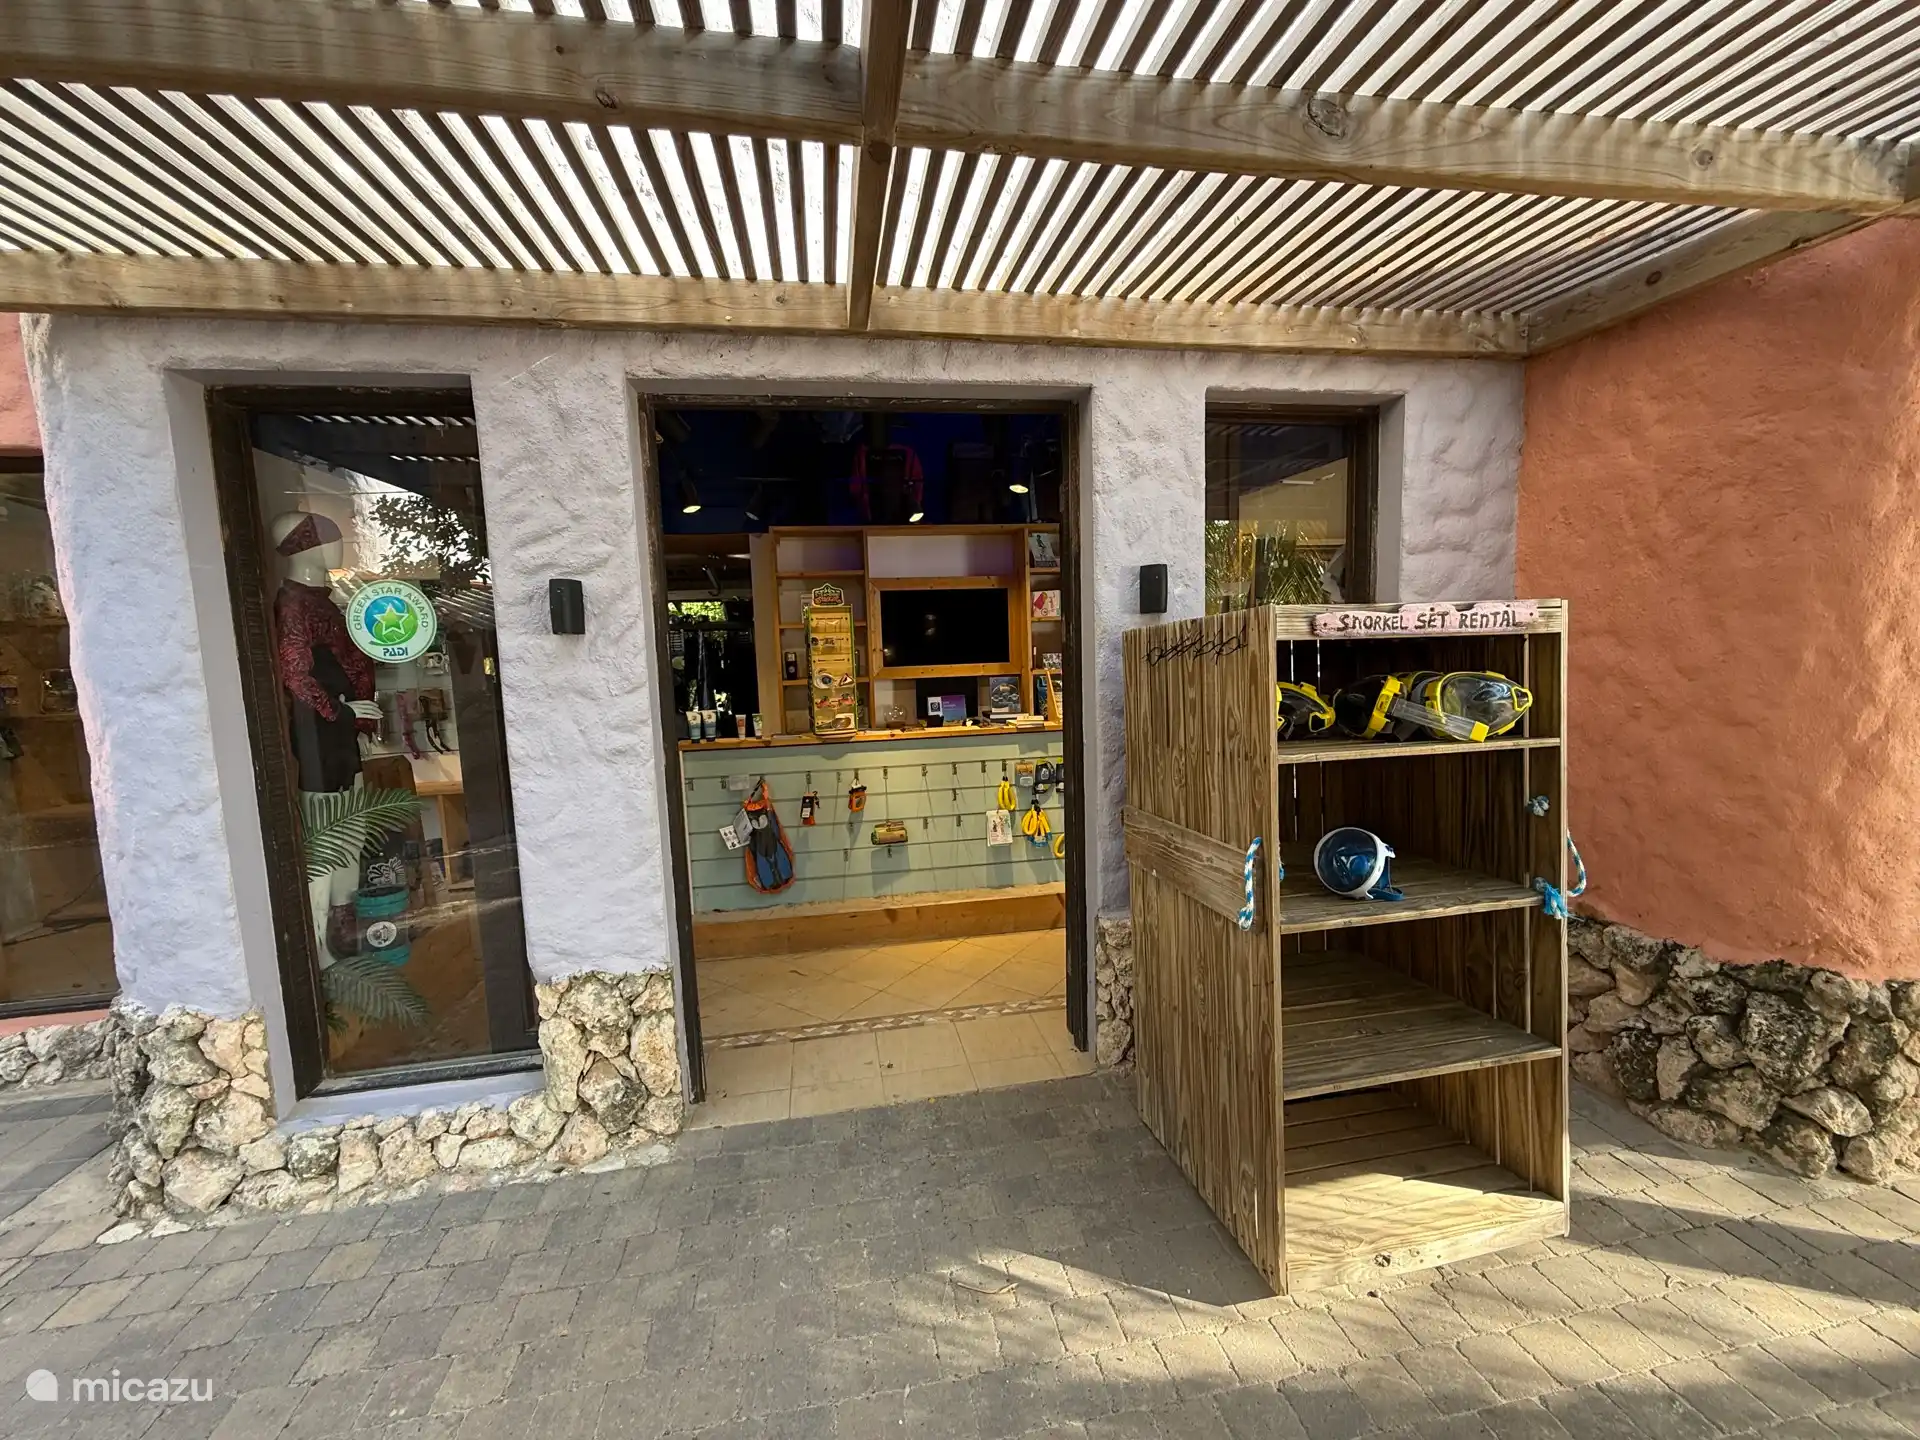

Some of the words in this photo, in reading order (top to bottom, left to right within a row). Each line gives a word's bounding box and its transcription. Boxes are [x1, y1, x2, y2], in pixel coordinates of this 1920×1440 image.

[353, 594, 371, 631] GREEN
[371, 586, 402, 597] STAR
[404, 592, 429, 628] AWARD
[1414, 610, 1450, 629] SET
[382, 647, 408, 656] PADI
